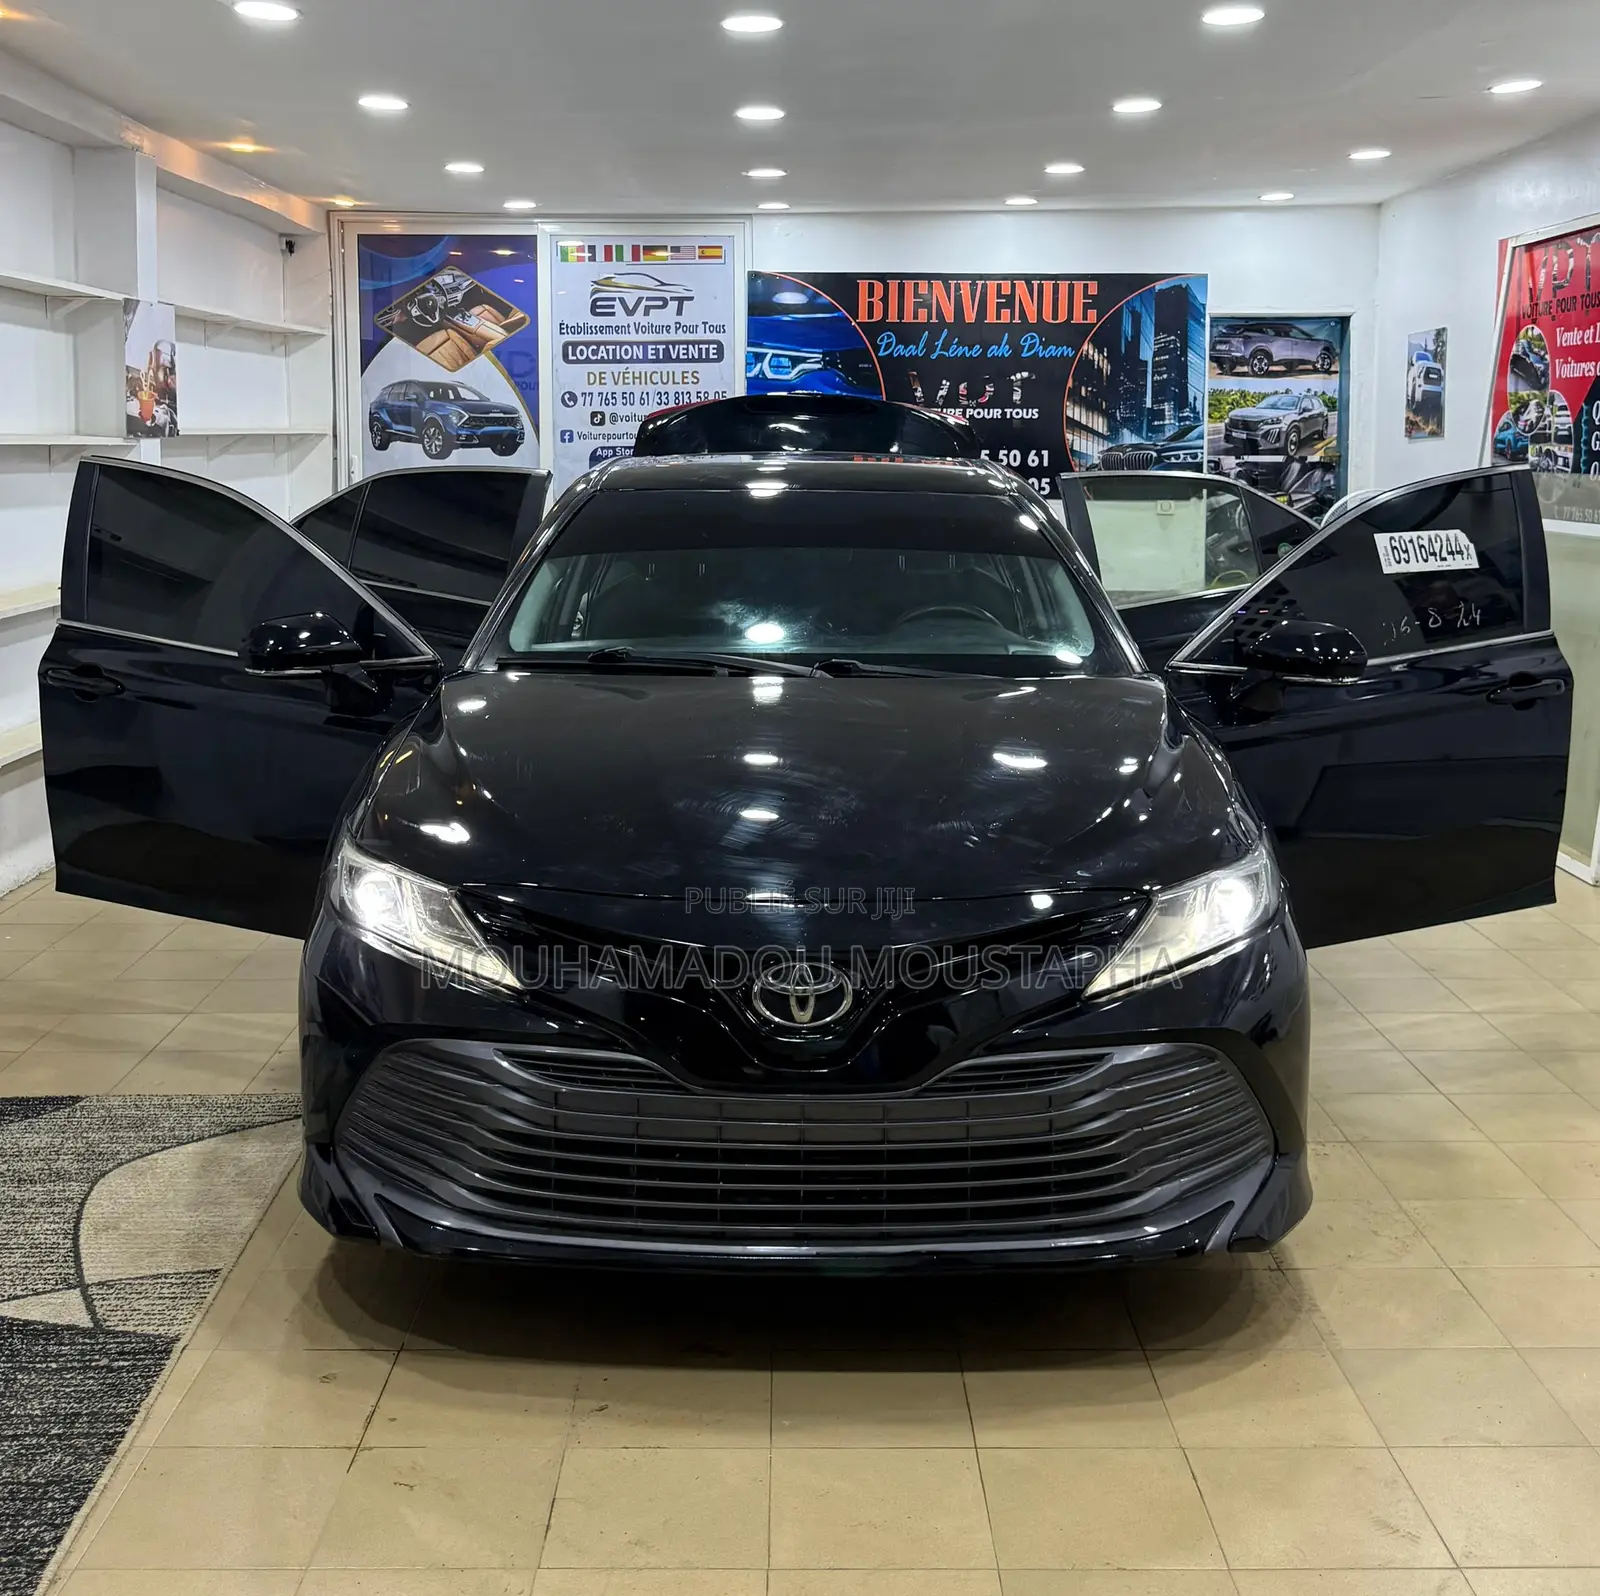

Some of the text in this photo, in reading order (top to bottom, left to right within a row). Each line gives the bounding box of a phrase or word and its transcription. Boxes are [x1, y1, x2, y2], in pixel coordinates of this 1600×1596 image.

[589, 296, 695, 317] EVPT
[856, 279, 1098, 324] BIENVENUE
[1521, 301, 1553, 320] VOITURE
[1555, 295, 1577, 314] POUR
[558, 319, 726, 336] Établissement Voiture Pour Tous
[1555, 326, 1583, 348] Vente
[1583, 324, 1594, 345] et
[567, 344, 719, 361] LOCATION ET VENTE
[876, 328, 929, 358] Daal
[986, 332, 1012, 358] ak
[1019, 331, 1076, 360] Diam
[586, 366, 700, 386] DE VÉHICULES
[1555, 356, 1596, 379] Voitures
[580, 391, 594, 407] 77
[597, 391, 618, 407] 765
[621, 391, 635, 407] 50
[673, 391, 692, 406] 813
[966, 408, 1002, 419] POUR
[1004, 408, 1039, 419] TOUS
[596, 447, 613, 459] App
[998, 449, 1021, 467] 50
[1027, 449, 1049, 467] 61
